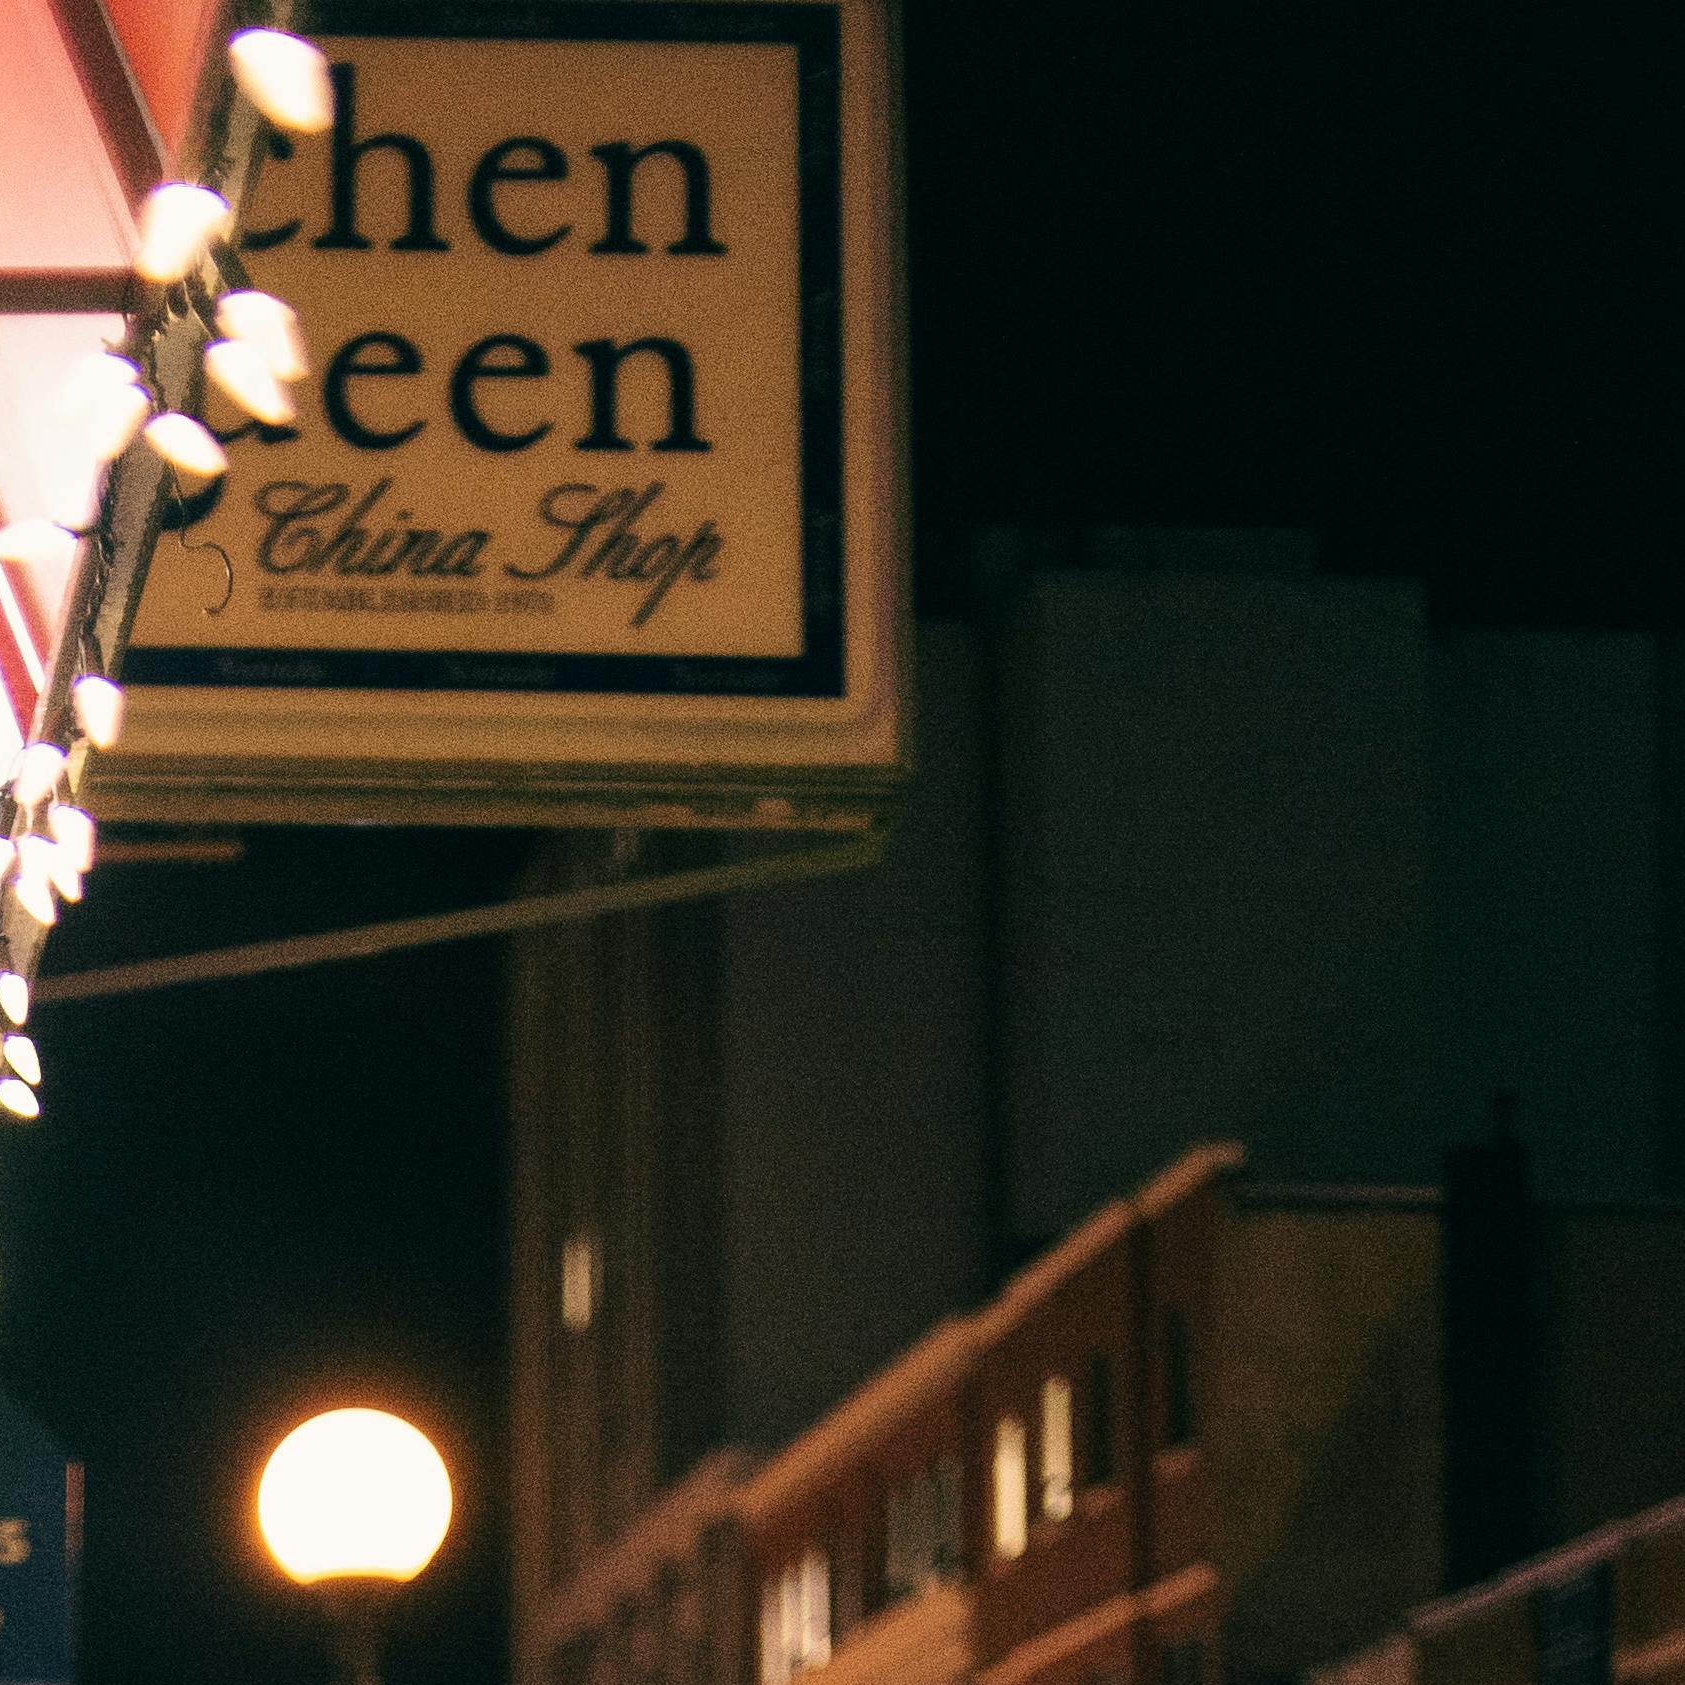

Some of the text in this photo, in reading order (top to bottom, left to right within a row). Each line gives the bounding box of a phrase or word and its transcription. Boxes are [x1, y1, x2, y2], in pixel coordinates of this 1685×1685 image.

[205, 328, 712, 462] een
[254, 480, 727, 626] China Shop
